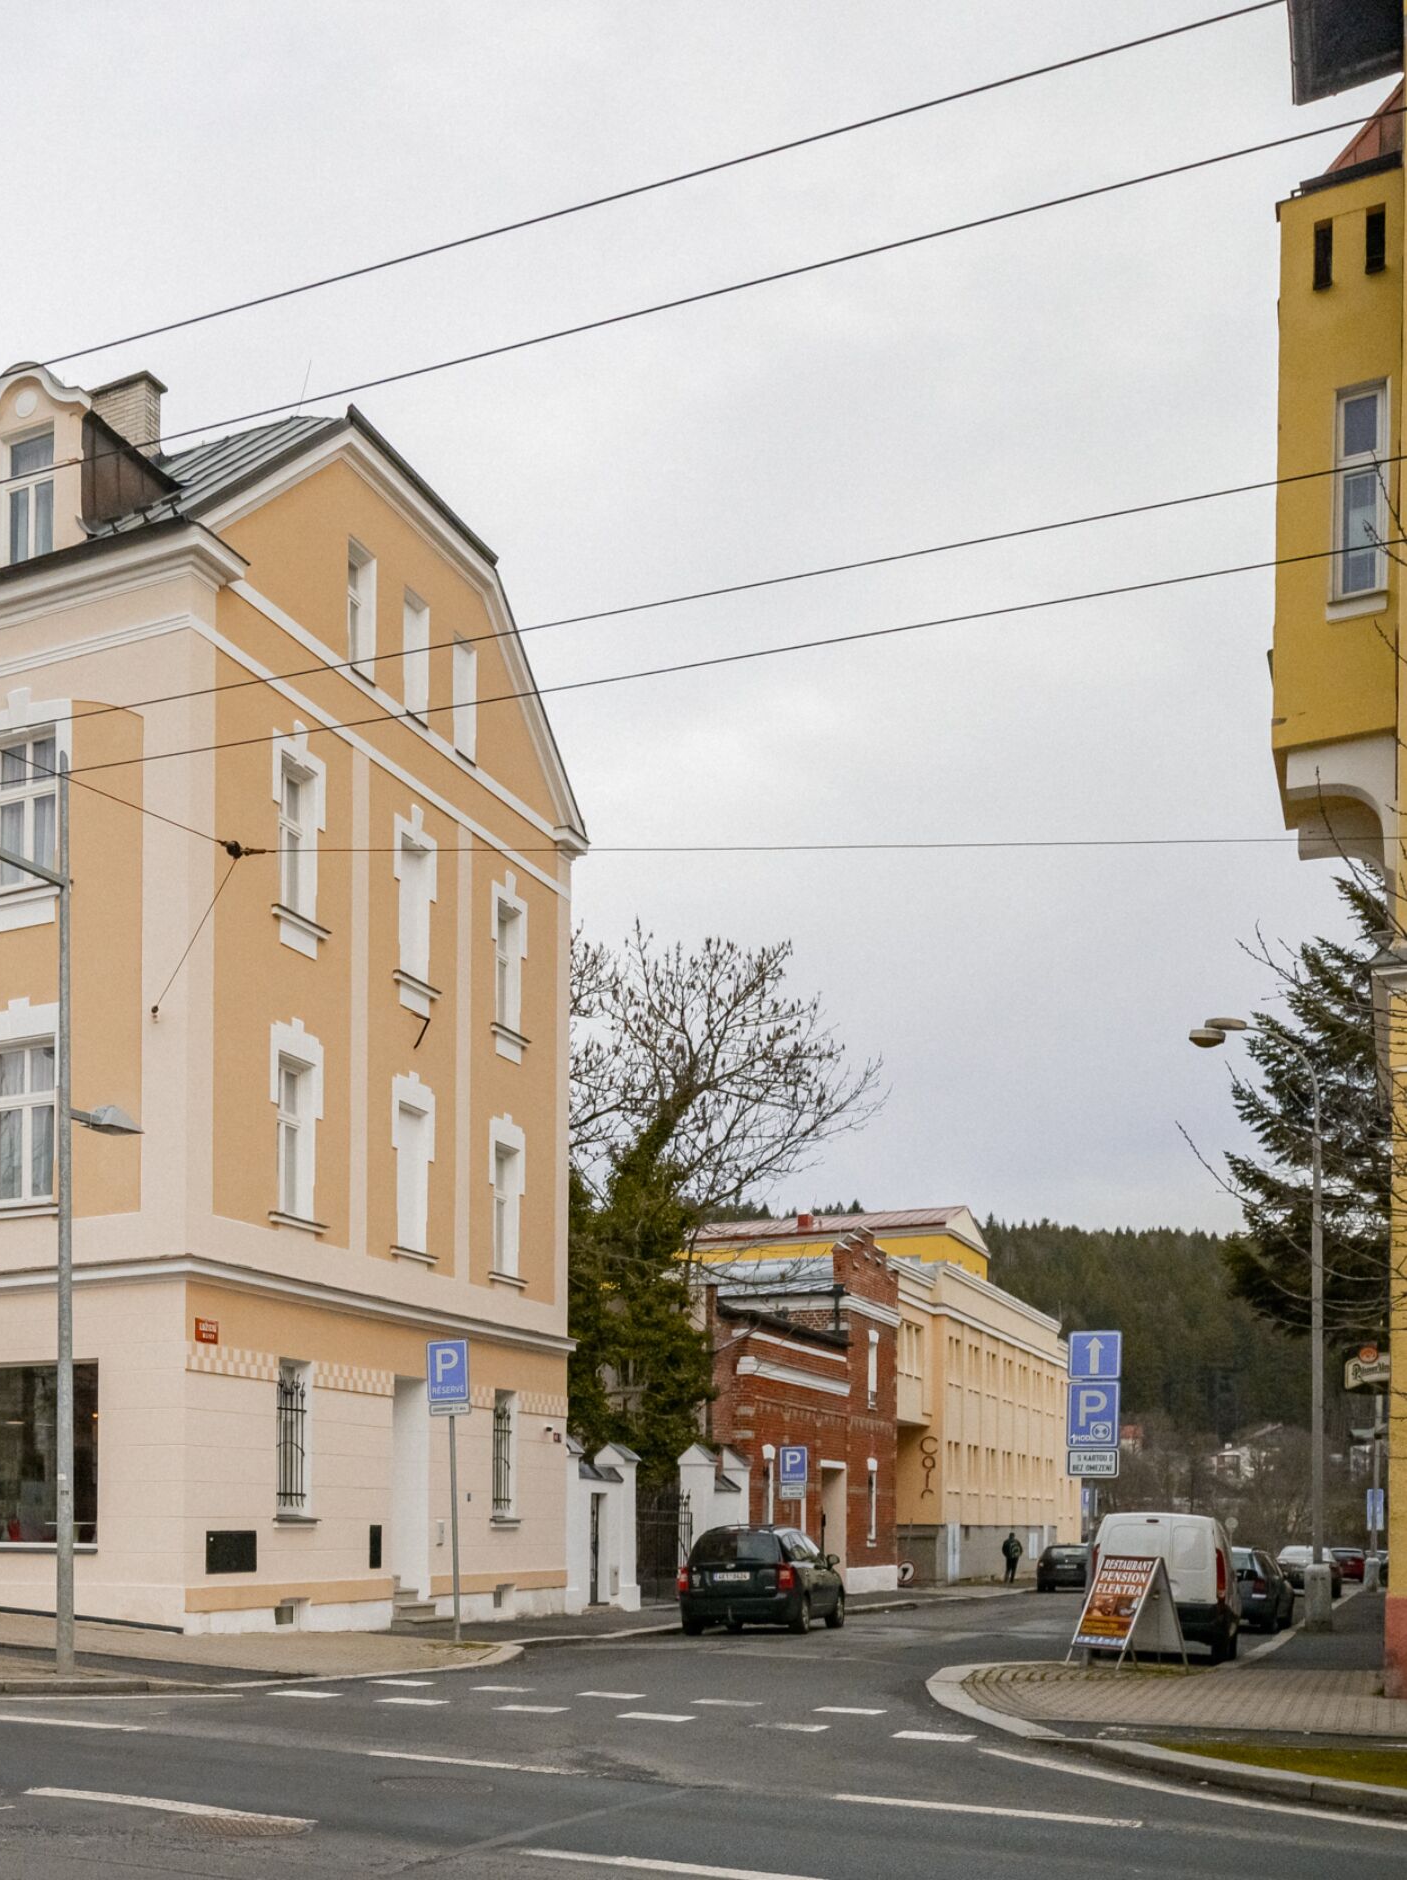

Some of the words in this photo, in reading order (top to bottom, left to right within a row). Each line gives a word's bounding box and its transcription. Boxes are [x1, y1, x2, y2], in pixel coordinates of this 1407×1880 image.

[436, 1348, 459, 1383] P
[1079, 1390, 1108, 1427] P
[786, 1451, 801, 1472] P
[1104, 1559, 1153, 1571] RESTAURANT
[1099, 1571, 1148, 1583] PENSION
[1095, 1583, 1143, 1596] ELEKTRA
